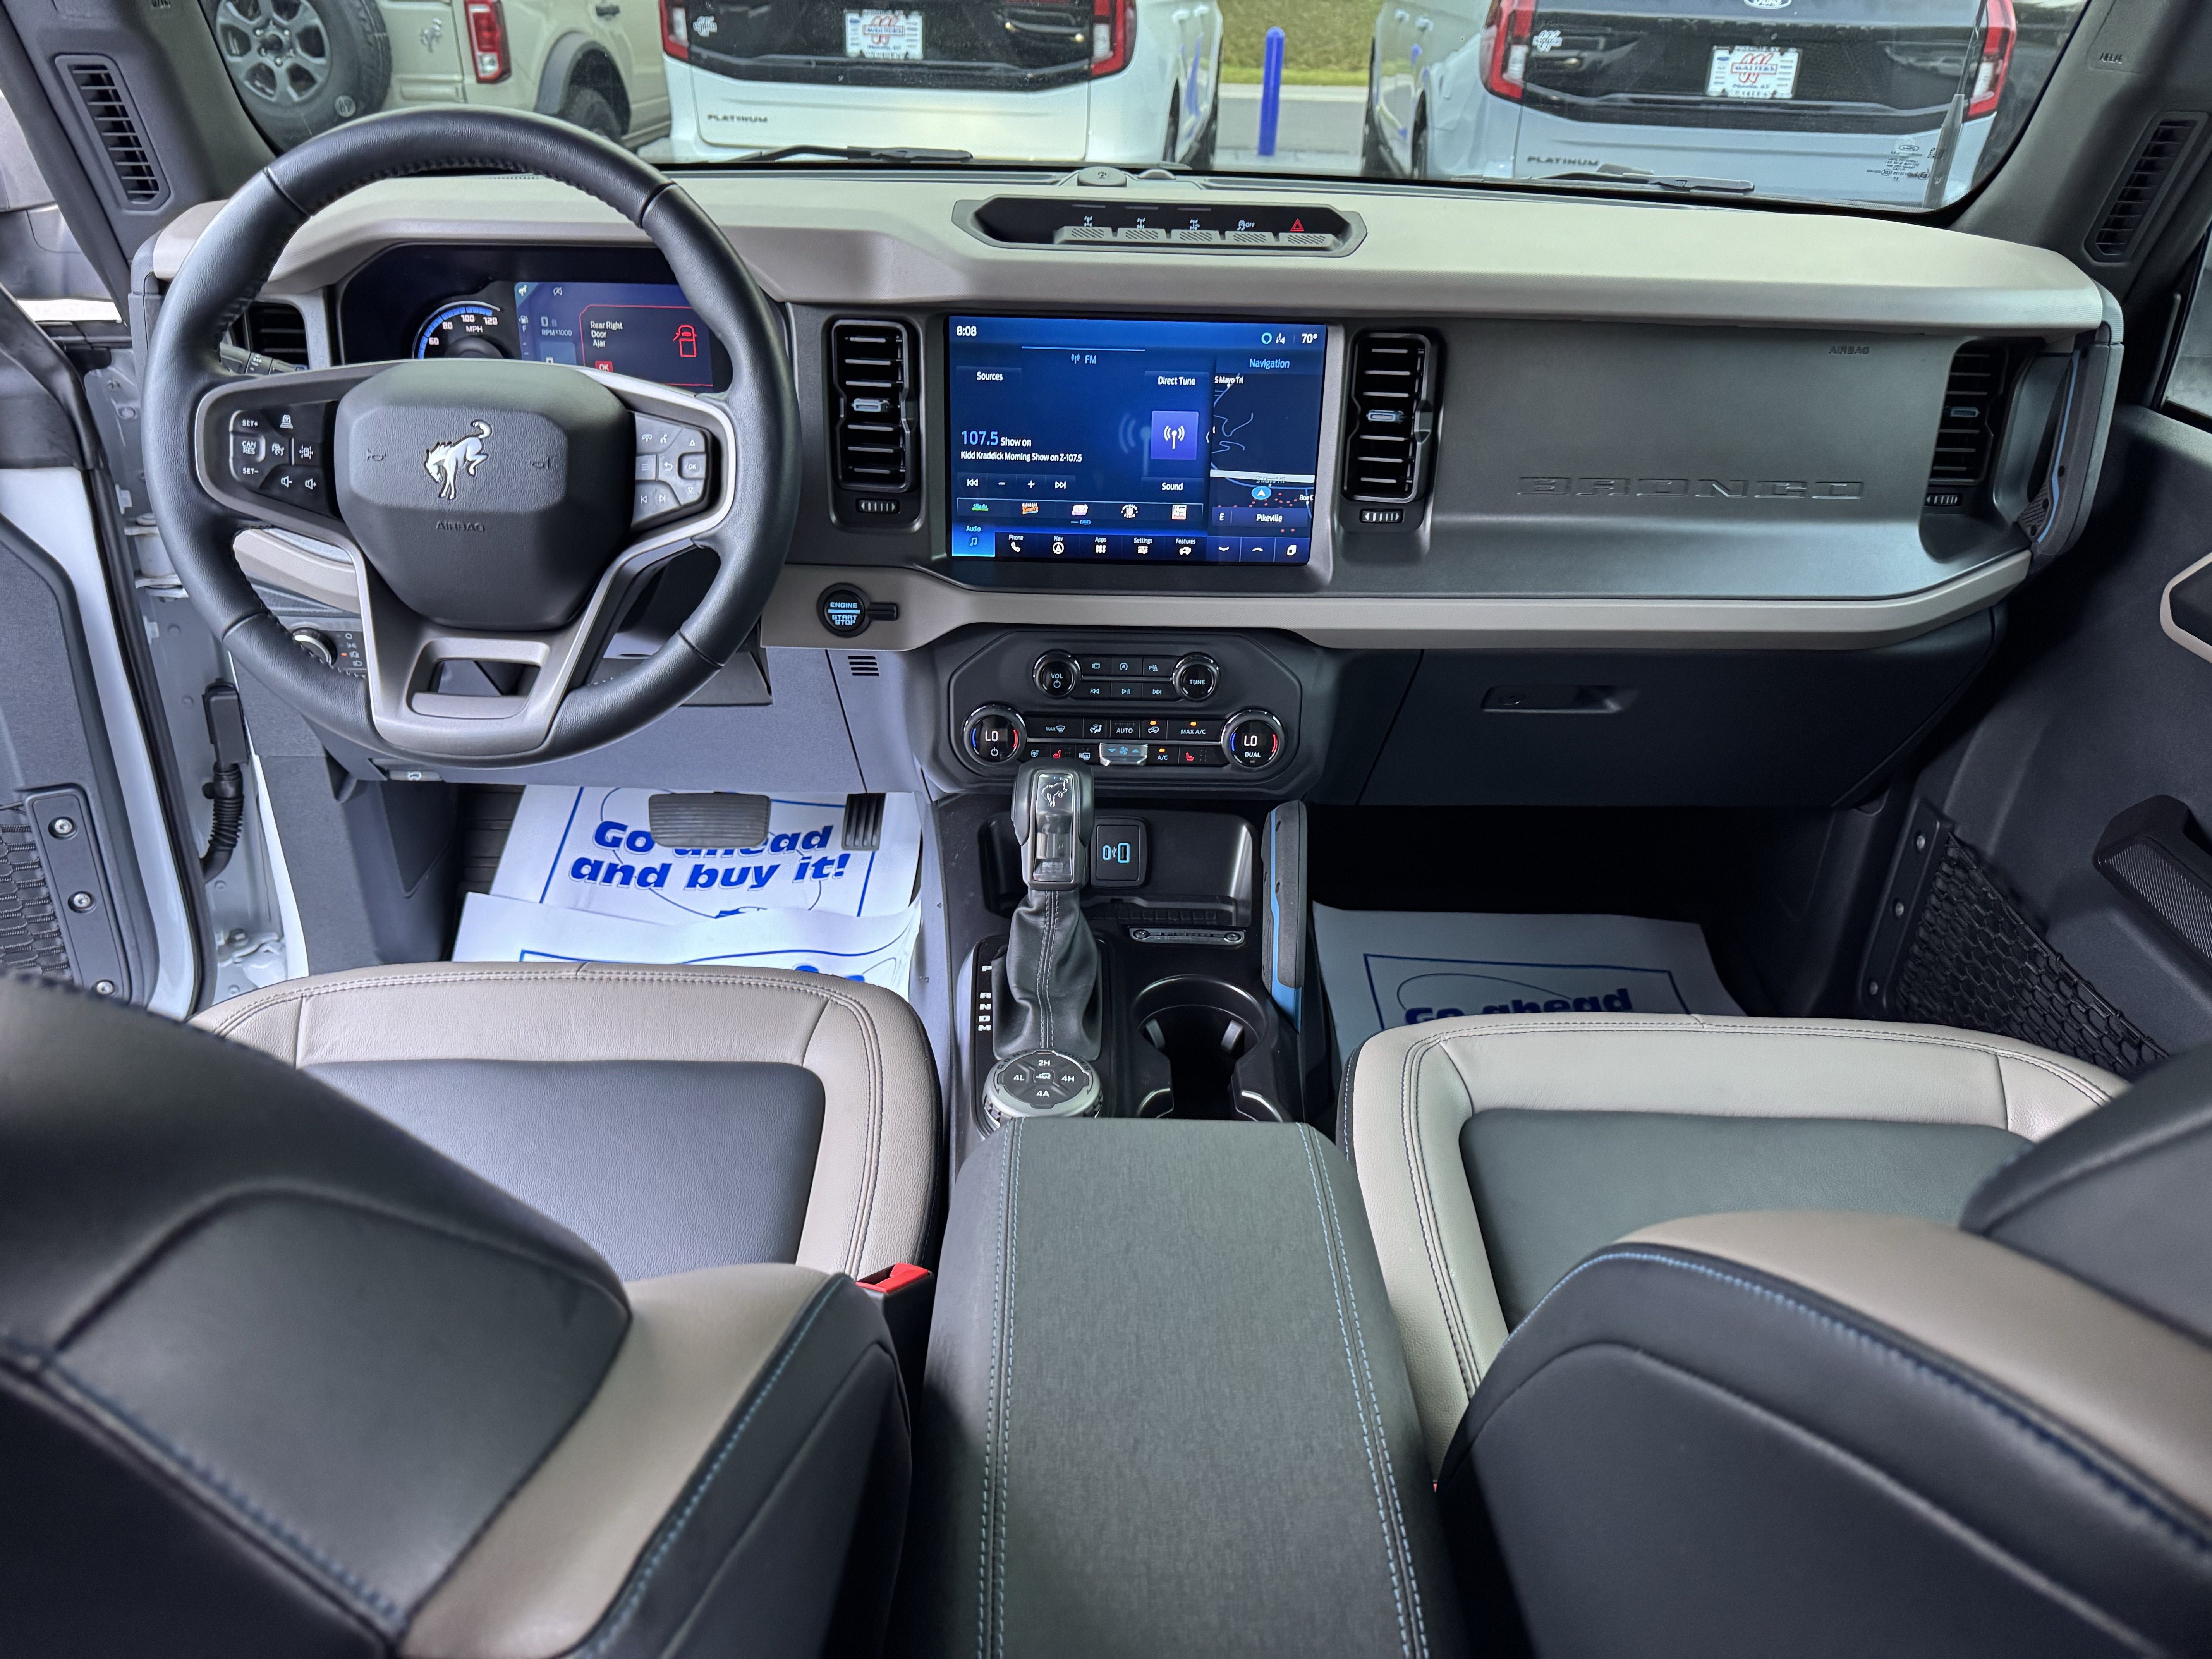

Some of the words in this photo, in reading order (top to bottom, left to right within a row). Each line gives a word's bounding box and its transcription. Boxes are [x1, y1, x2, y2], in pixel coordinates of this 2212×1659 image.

[1527, 156, 1599, 166] PLATINUM
[461, 314, 475, 323] 100
[483, 317, 498, 325] 120
[442, 321, 453, 330] 80
[465, 325, 483, 333] MPH
[590, 321, 605, 329] Rear
[606, 321, 623, 330] Right
[591, 330, 606, 338] Door
[956, 325, 977, 337] 8:08
[428, 337, 439, 345] 60
[593, 339, 606, 348] Ajar
[1085, 355, 1097, 364] FM
[1249, 358, 1290, 369] Navigation
[599, 363, 609, 372] OK
[976, 371, 1003, 381] Sources
[1214, 376, 1219, 384] S
[1219, 376, 1235, 385] Mayo
[1158, 376, 1178, 385] Direct
[1178, 376, 1196, 386] Tune
[962, 430, 999, 446] 107.5
[1000, 437, 1021, 447] Show
[1022, 439, 1032, 447] on
[961, 450, 975, 459] Kidd
[976, 451, 1004, 460] Kraddick
[1005, 452, 1030, 462] Morning
[1031, 452, 1049, 461] Show
[1060, 453, 1082, 462] Z-107.5
[1161, 482, 1183, 491] Sound
[1517, 477, 1865, 500] BRONCO
[1219, 513, 1224, 521] E
[1256, 514, 1283, 522] Pikeville
[435, 520, 486, 532] AIRBAG
[985, 730, 998, 742] LO
[1244, 735, 1257, 747] LO
[594, 821, 655, 853] Go
[570, 857, 673, 890] and
[684, 864, 781, 891] buy
[792, 853, 851, 883] it!
